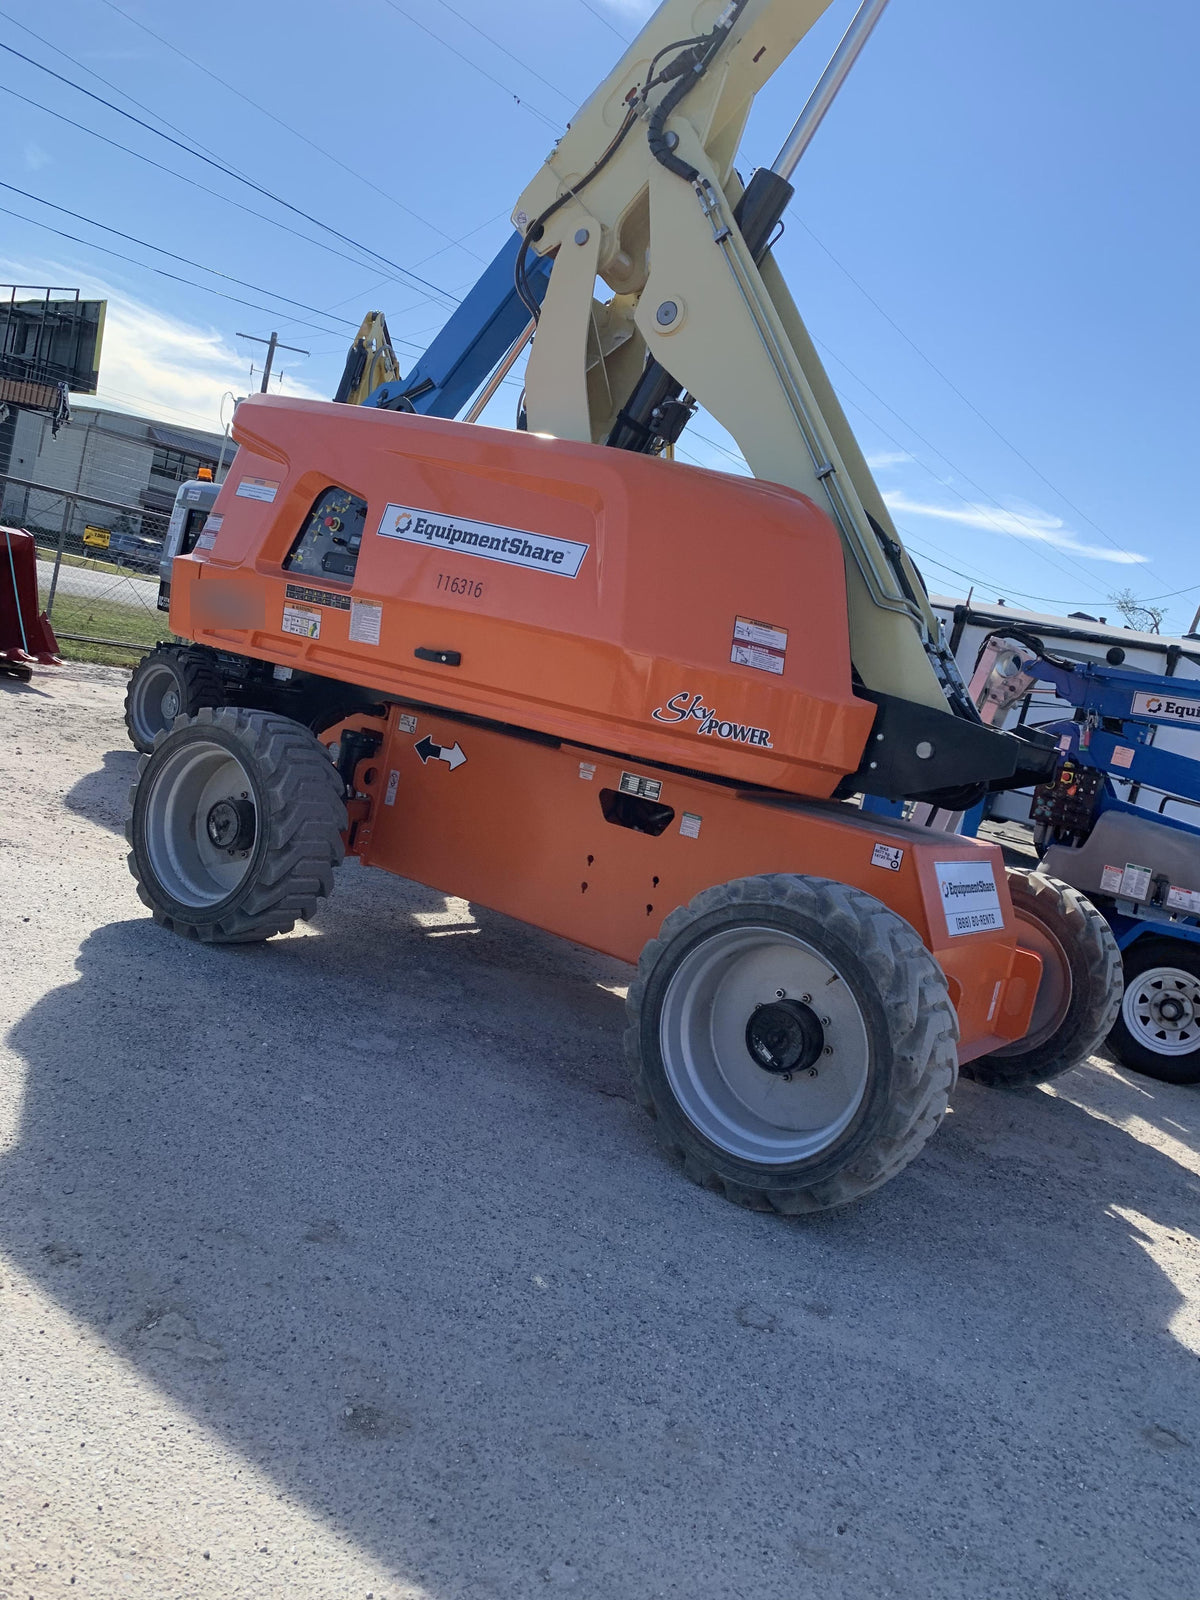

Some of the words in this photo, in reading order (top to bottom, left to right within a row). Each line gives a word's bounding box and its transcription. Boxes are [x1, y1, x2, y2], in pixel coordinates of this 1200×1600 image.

[412, 517, 565, 565] EquipmentShare
[436, 573, 484, 599] 116316
[652, 692, 716, 734] Sky
[707, 718, 772, 748] POWER
[948, 880, 996, 898] EquipmentShare
